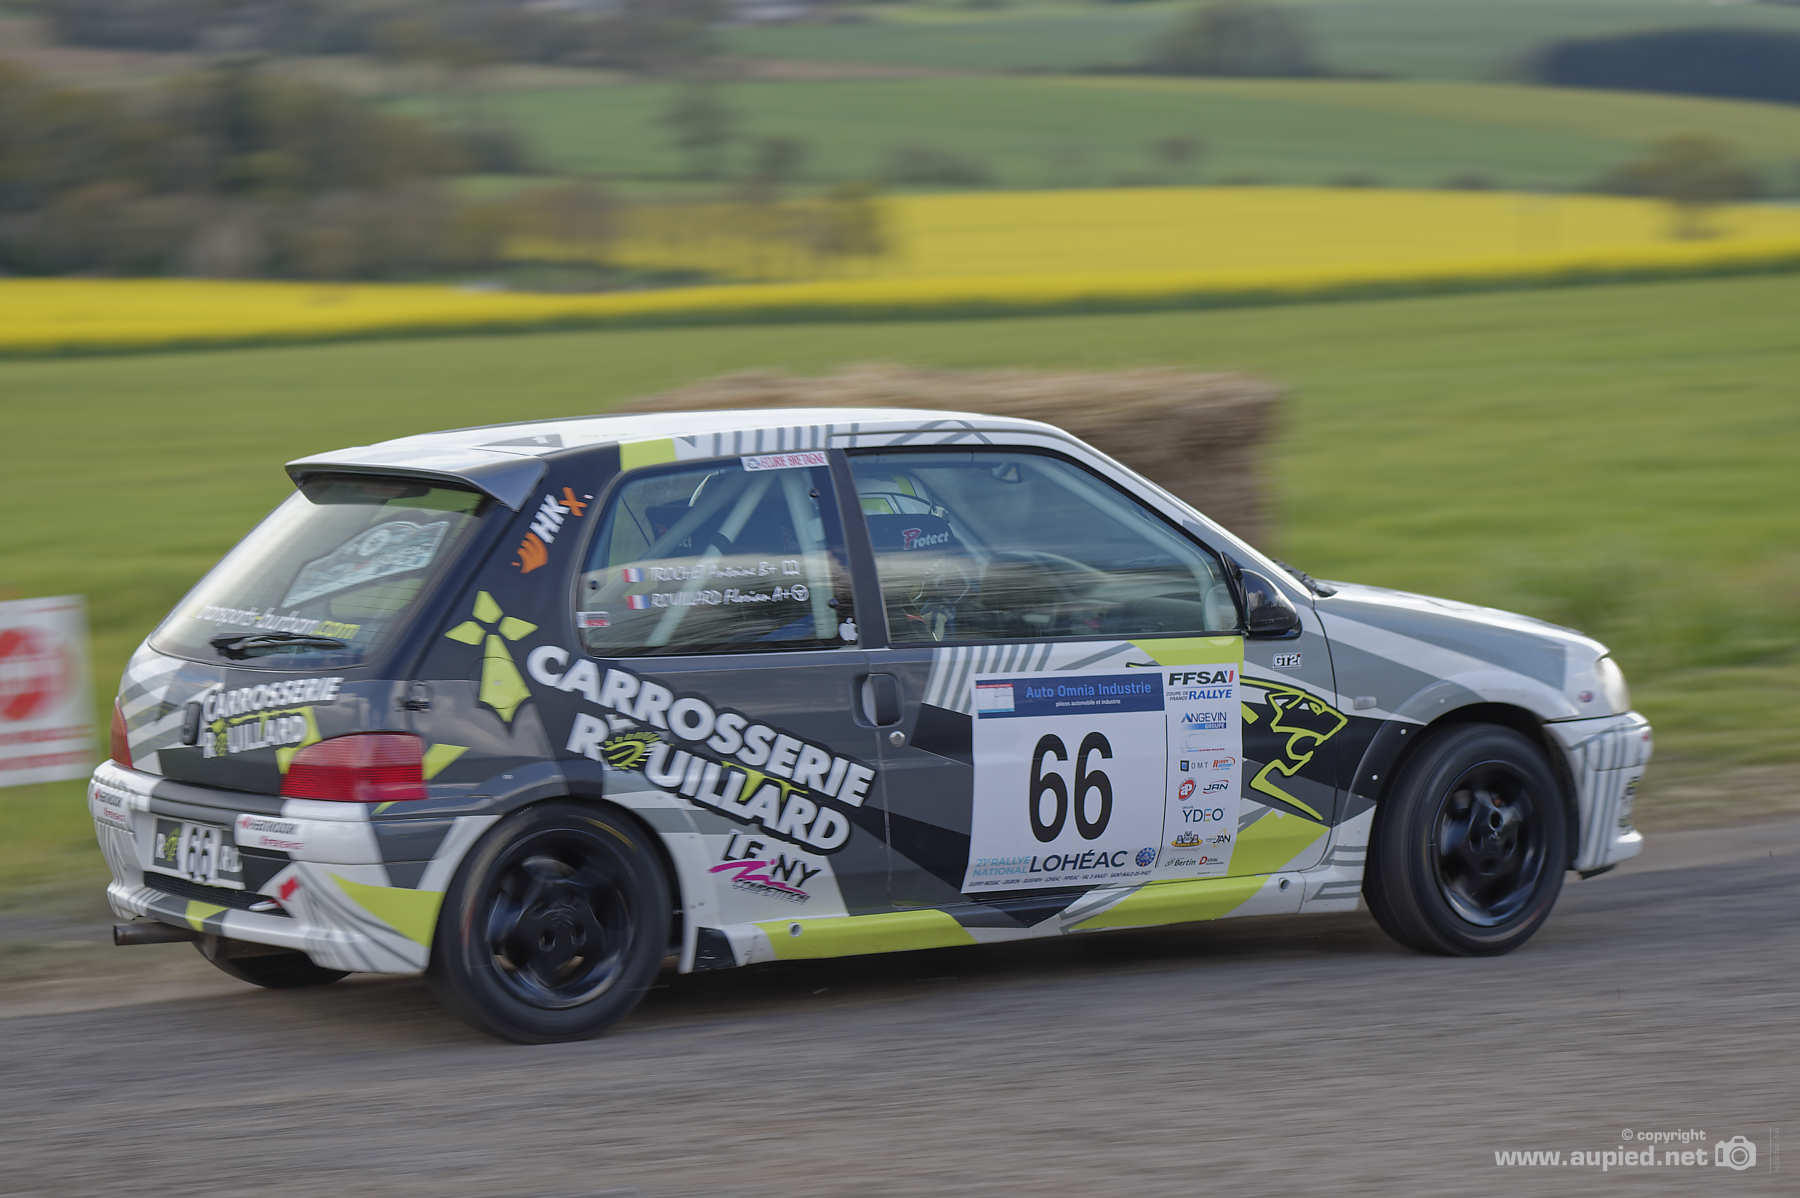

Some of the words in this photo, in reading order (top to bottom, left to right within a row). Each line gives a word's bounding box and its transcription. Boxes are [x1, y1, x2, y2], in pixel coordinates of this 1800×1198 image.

[1168, 671, 1228, 687] FFSA
[203, 677, 345, 723] CARROSSERIE
[1026, 685, 1054, 699] Auto
[1057, 684, 1095, 698] Omnia
[1099, 681, 1151, 696] Industrie
[1188, 689, 1233, 701] RALLYE
[527, 646, 876, 809] CARROSSERIE
[1181, 712, 1227, 723] ANGEVIN
[1029, 731, 1113, 842] 66
[1029, 849, 1128, 873] LOHÉAC
